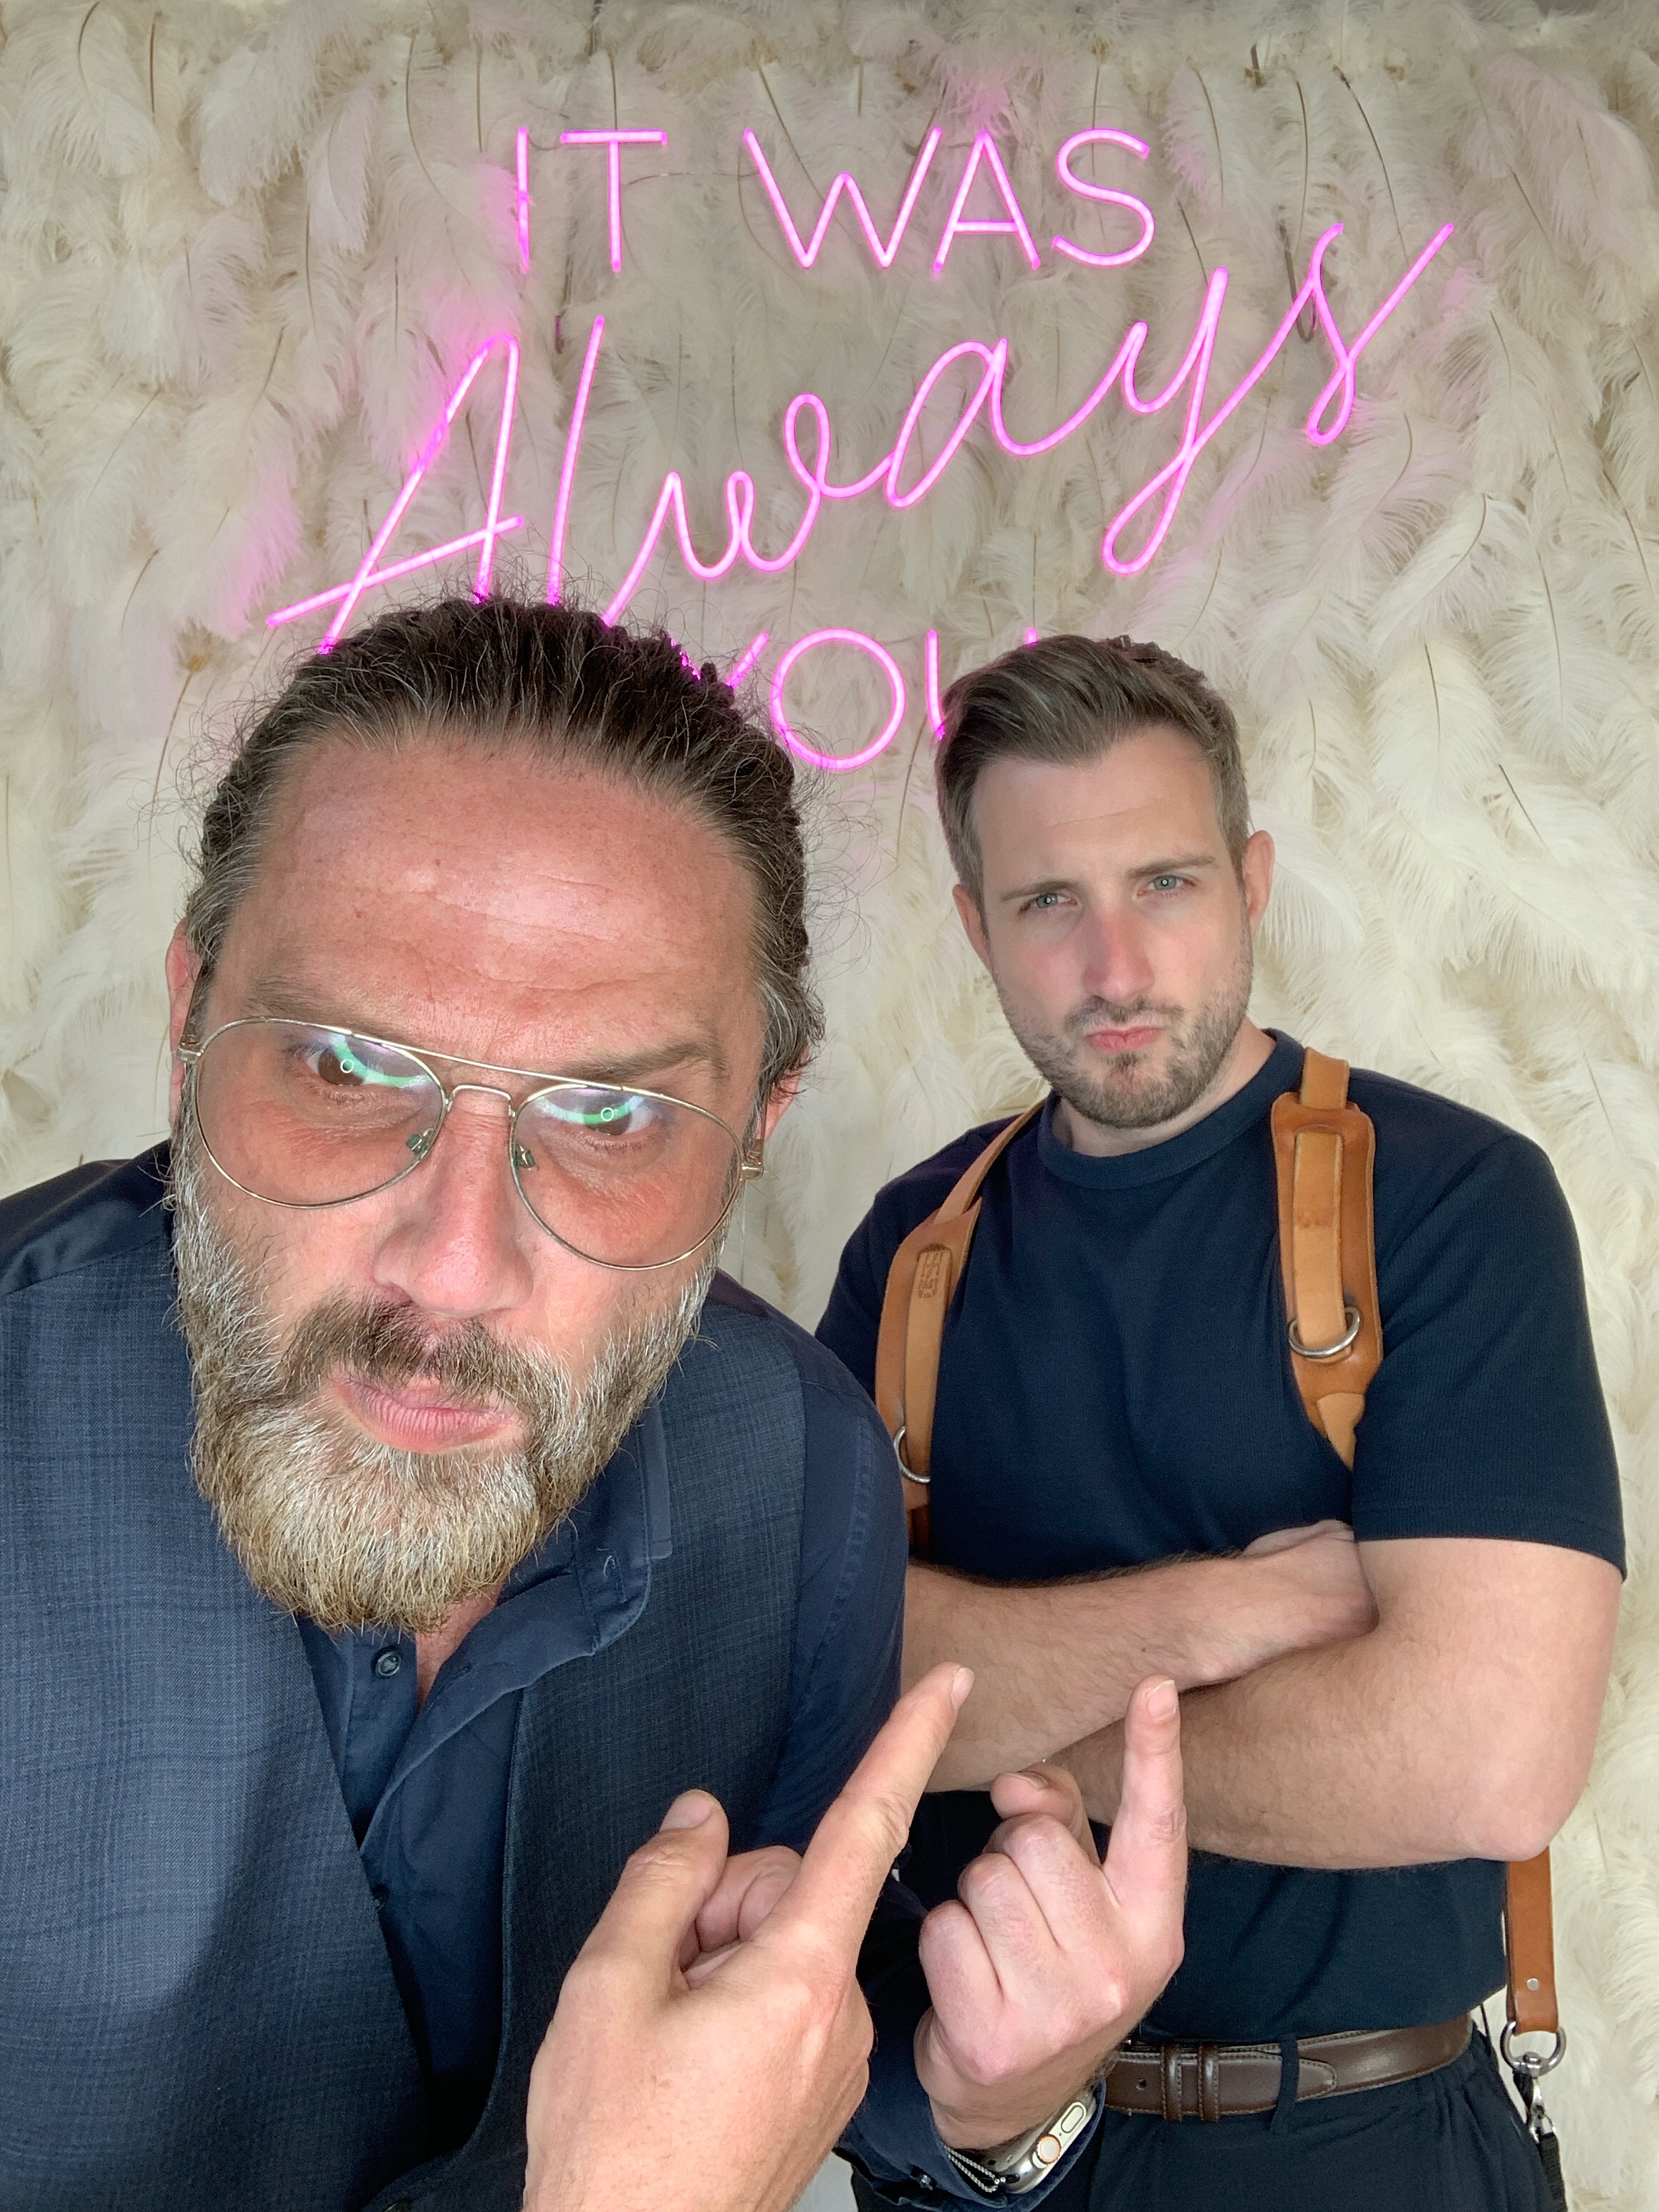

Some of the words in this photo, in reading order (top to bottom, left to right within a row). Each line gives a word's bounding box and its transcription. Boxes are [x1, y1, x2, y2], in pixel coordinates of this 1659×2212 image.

[515, 126, 668, 272] IT
[742, 126, 1156, 274] WAS
[266, 221, 1455, 655] Always
